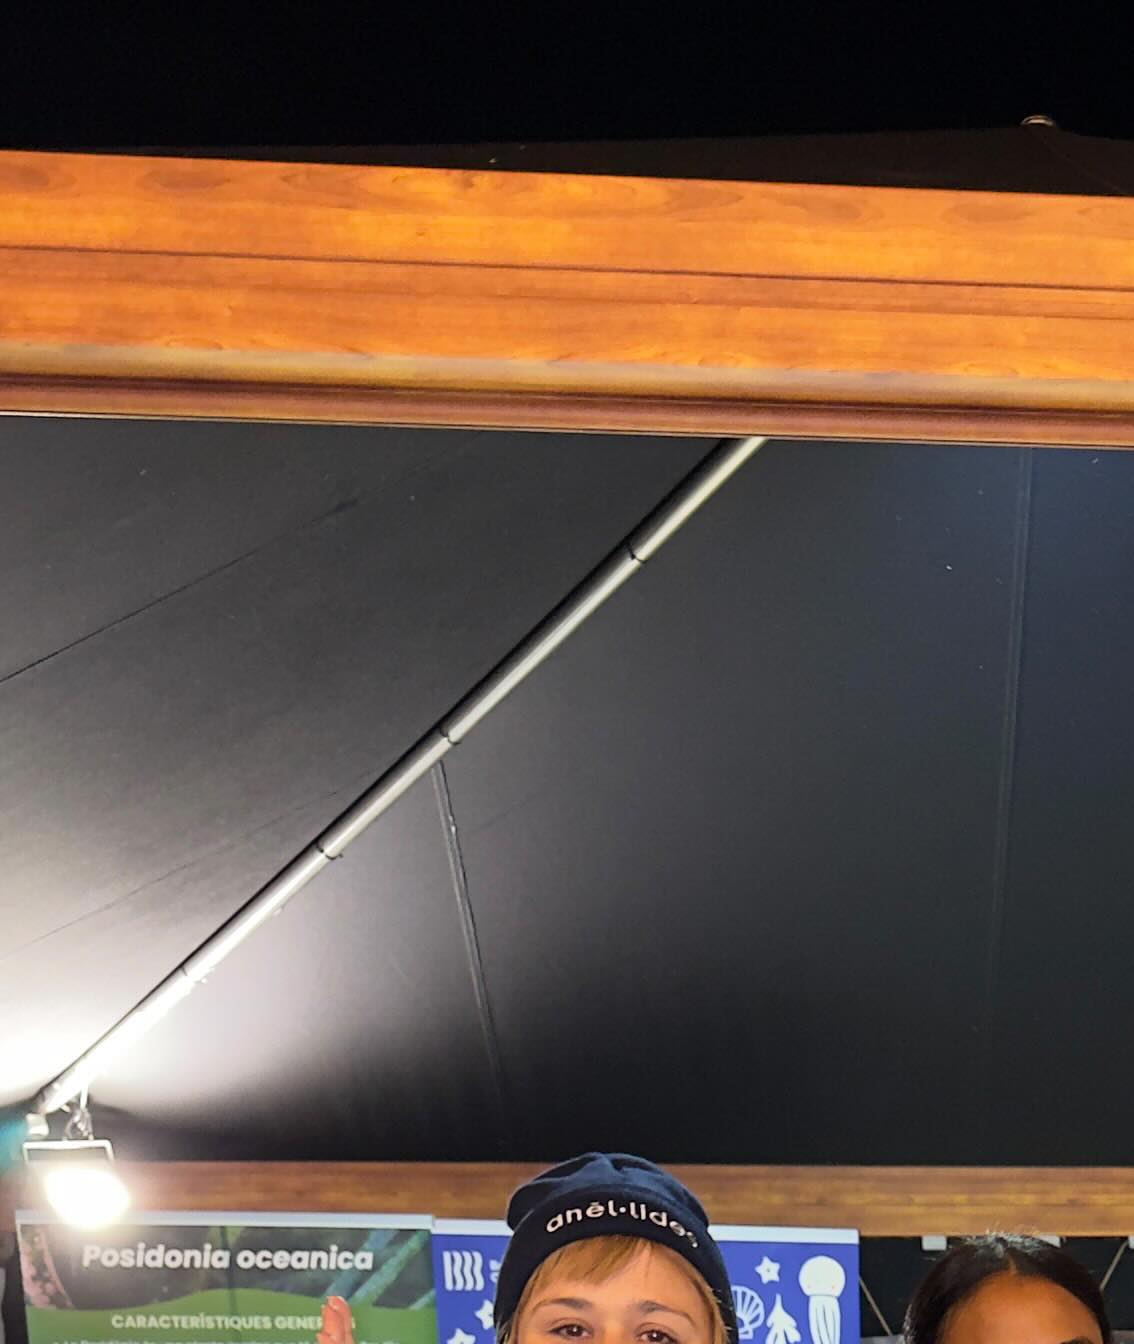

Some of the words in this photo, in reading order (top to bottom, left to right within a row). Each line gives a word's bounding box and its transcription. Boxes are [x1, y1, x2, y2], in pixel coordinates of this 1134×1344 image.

[82, 1243, 230, 1269] Posidonia
[236, 1244, 374, 1270] oceanica
[111, 1312, 272, 1330] CARACTERÍSTIQUES
